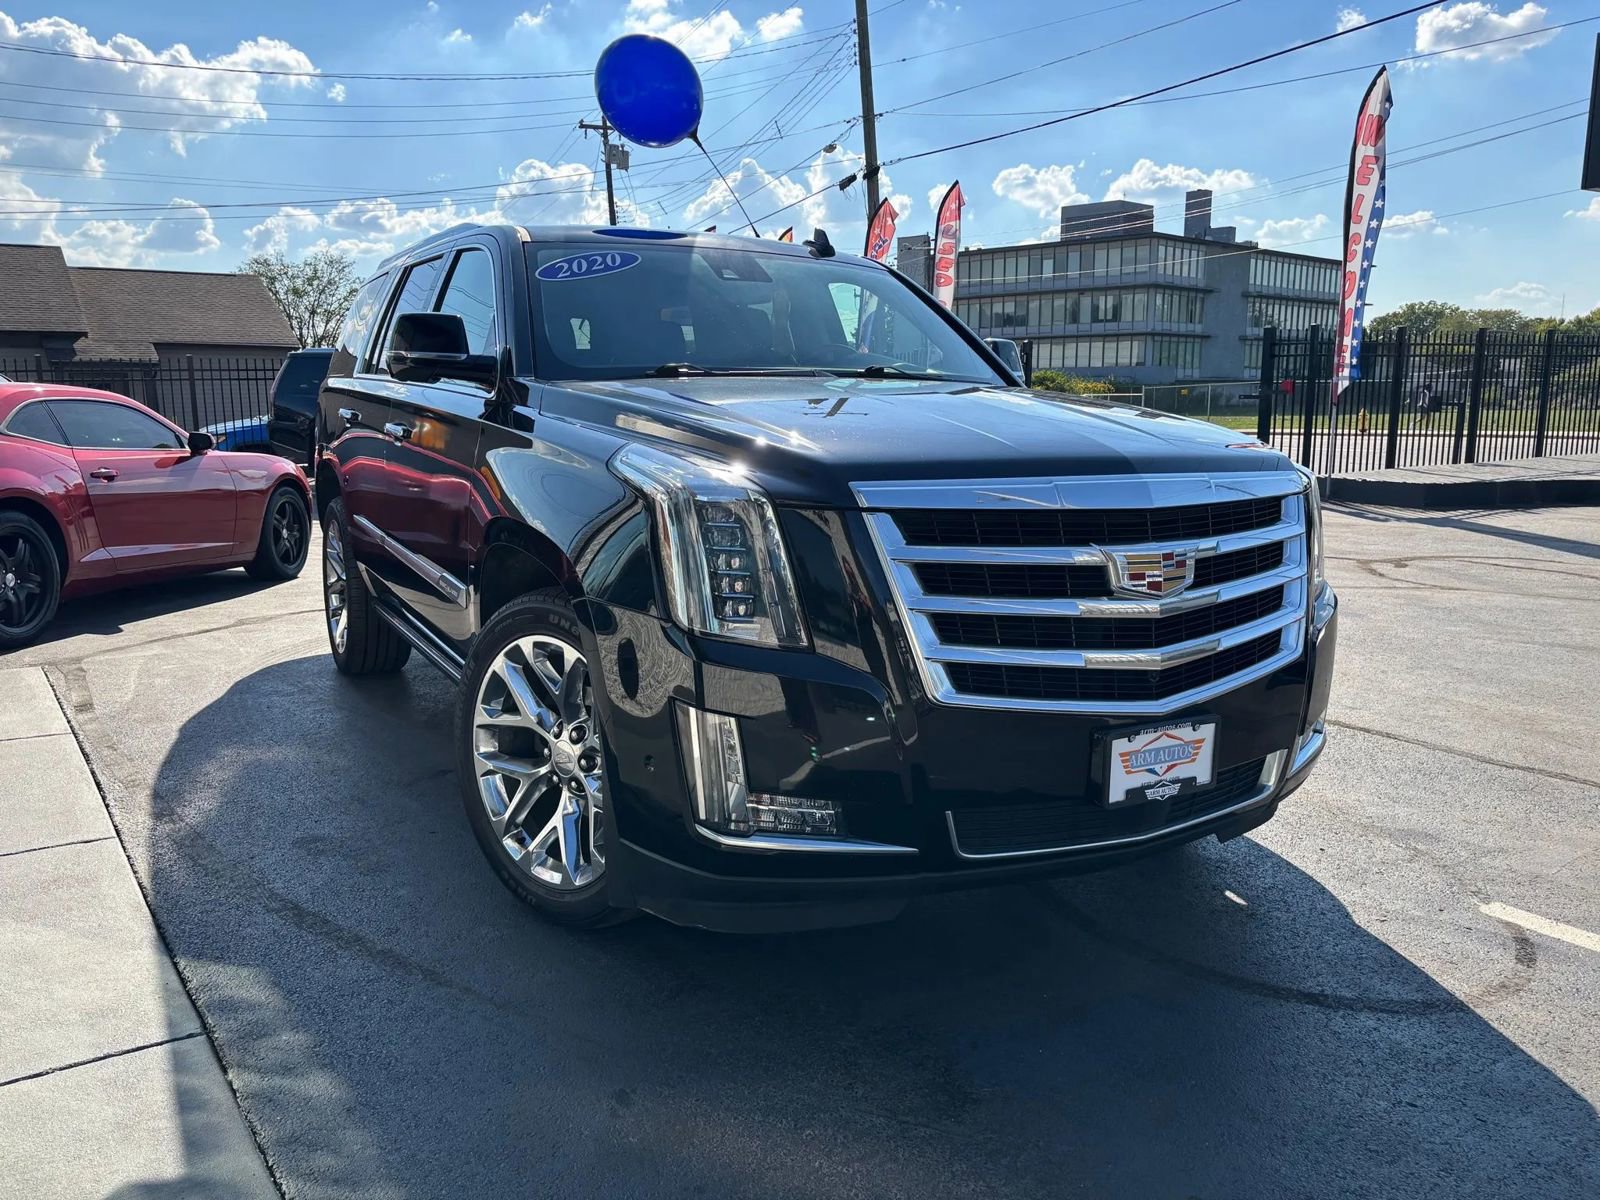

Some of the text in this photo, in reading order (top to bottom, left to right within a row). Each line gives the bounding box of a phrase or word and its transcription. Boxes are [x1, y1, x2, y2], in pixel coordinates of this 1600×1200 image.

[554, 252, 621, 279] 2020
[1130, 743, 1194, 767] ARM AUTOS
